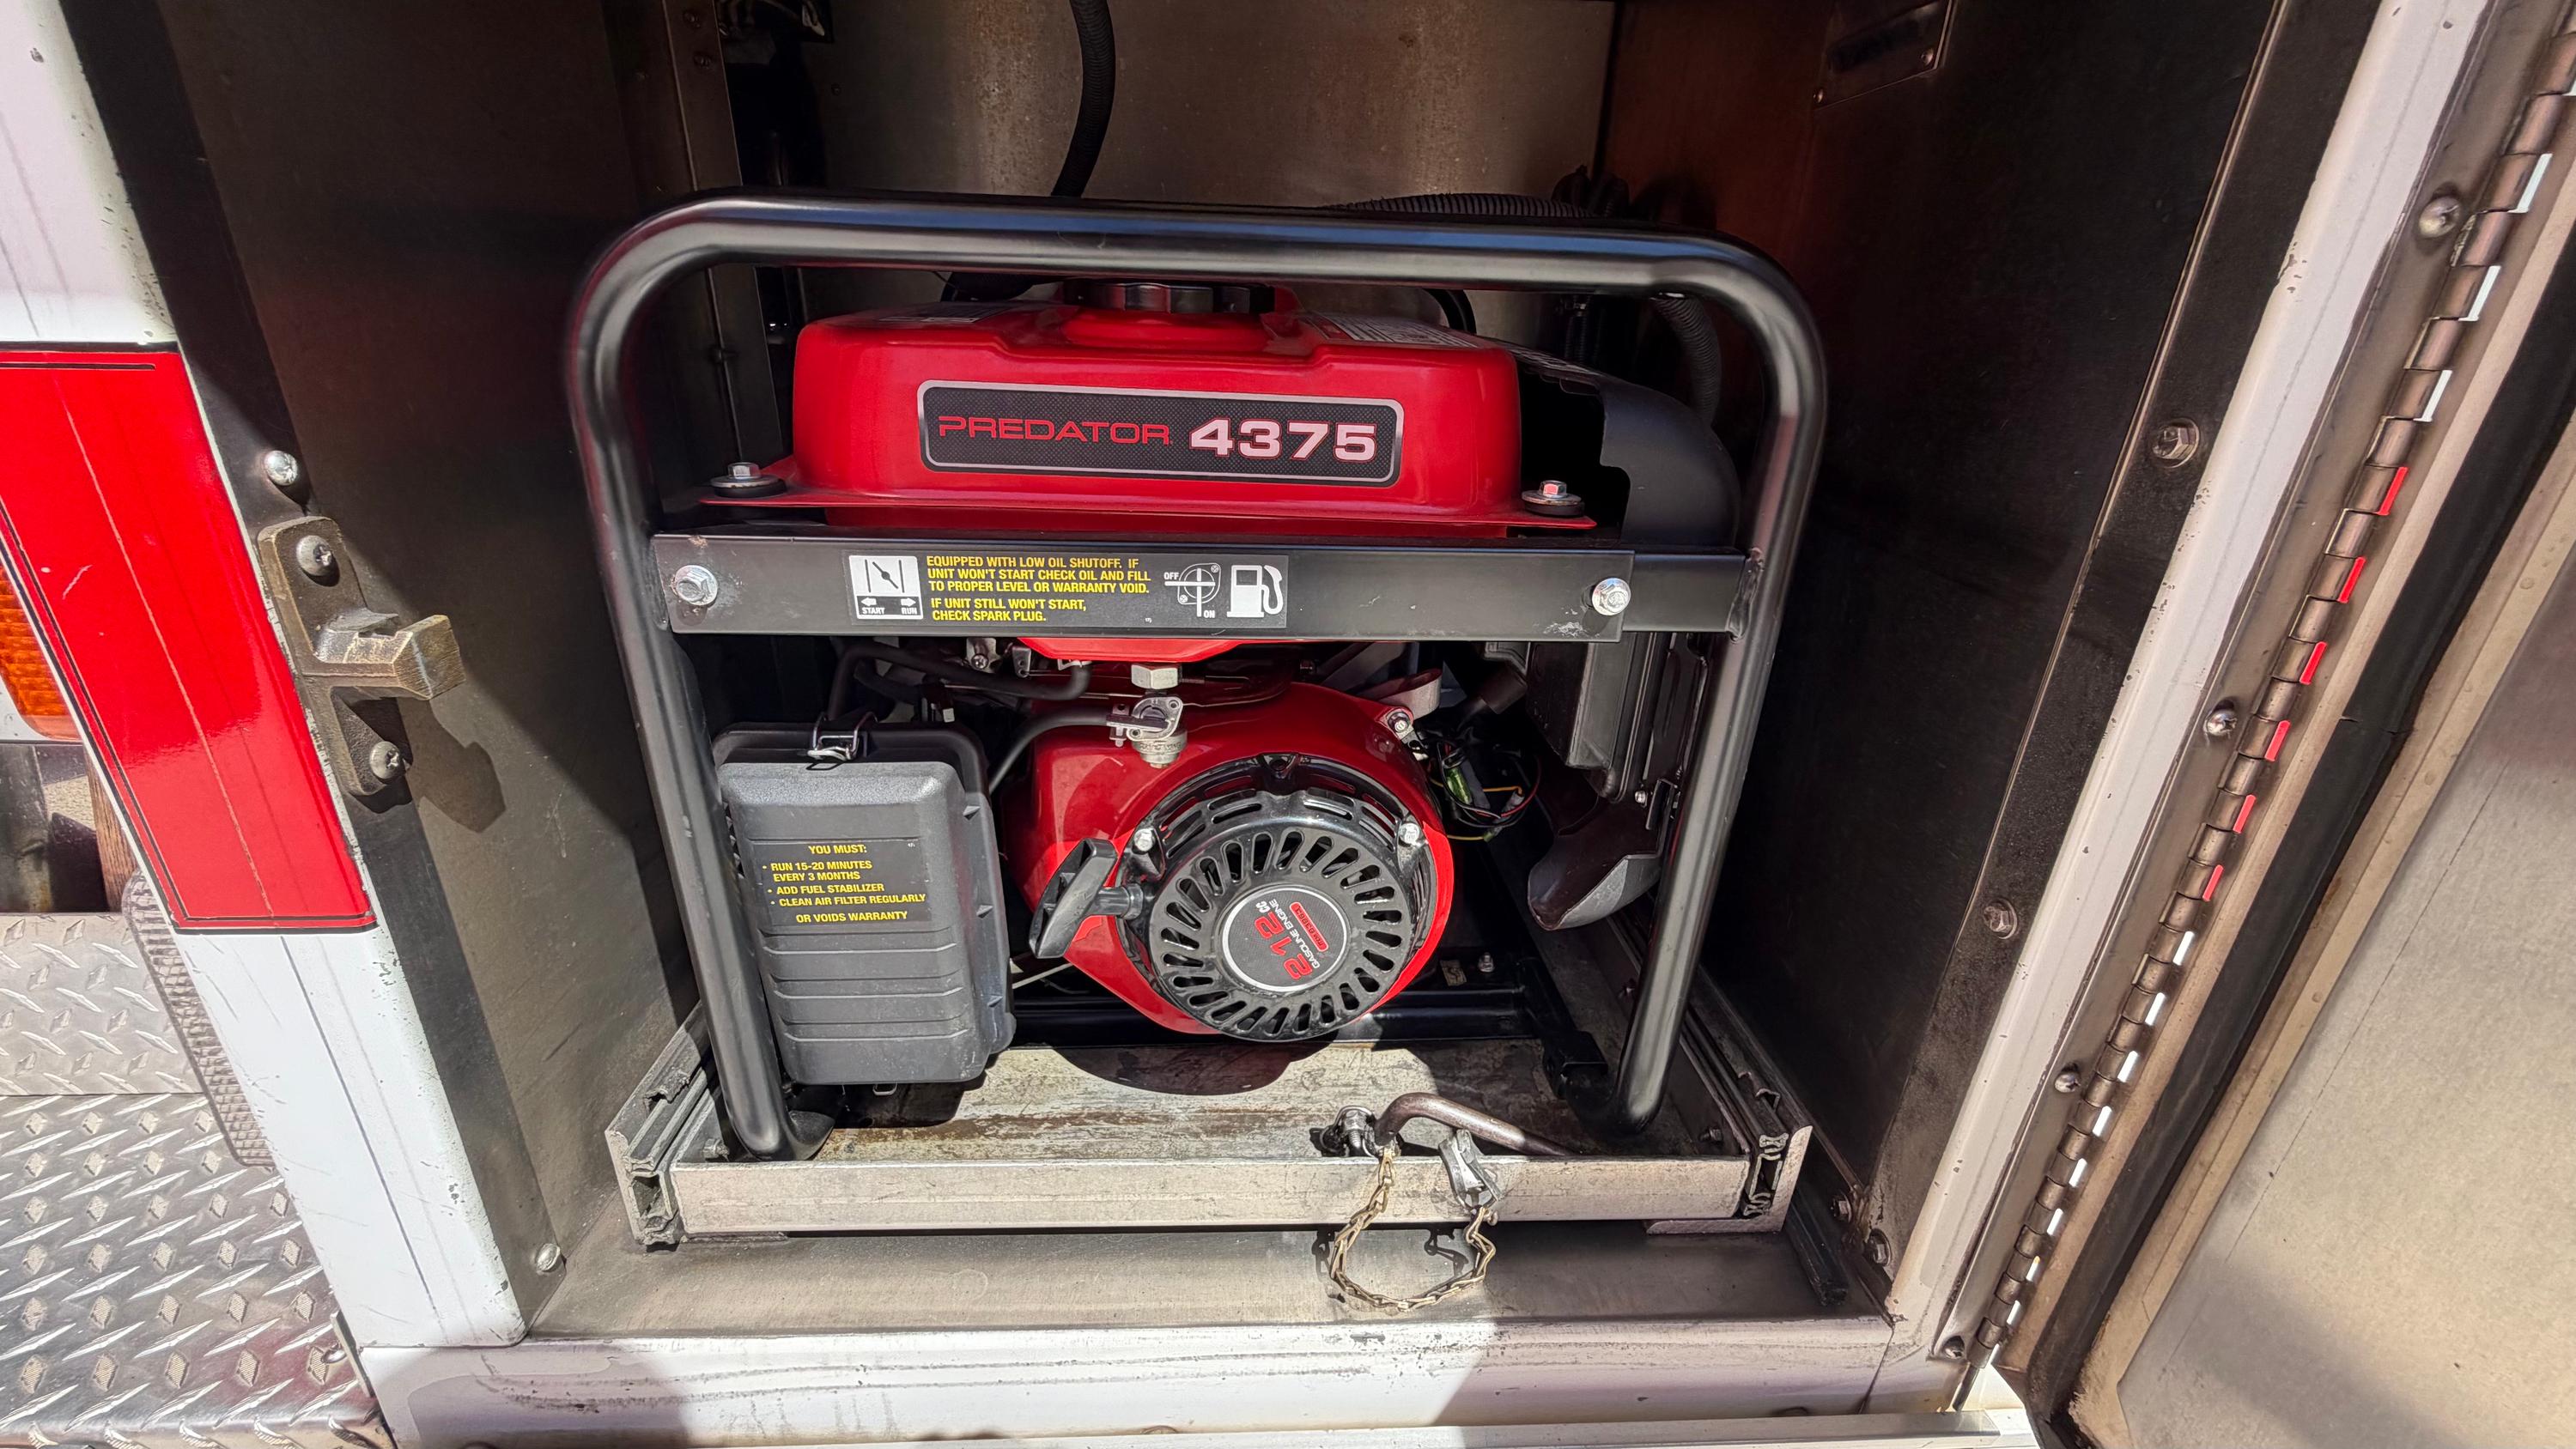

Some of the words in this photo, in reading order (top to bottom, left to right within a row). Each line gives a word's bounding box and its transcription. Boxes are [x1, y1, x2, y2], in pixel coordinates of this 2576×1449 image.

[938, 415, 1171, 446] PREDATOR
[1188, 417, 1378, 464] 4375
[927, 555, 983, 567] EQUIPPED
[987, 556, 1017, 567] WITH
[1019, 557, 1045, 567] LOW
[1048, 557, 1066, 568] OIL
[1069, 558, 1122, 569] SHUTOFF.
[1128, 558, 1139, 569] IF
[927, 568, 955, 579] UNIT
[957, 568, 996, 579] WON'T
[999, 569, 1036, 580] START
[1038, 569, 1076, 580] CHECK
[1078, 570, 1098, 581] OIL
[1100, 570, 1125, 581] AND
[1127, 571, 1151, 581] FILL
[1163, 572, 1180, 580] OFF
[928, 580, 945, 591] TO
[947, 581, 993, 592] PROPER
[996, 581, 1031, 592] LEVEL
[1033, 582, 1050, 592] OR
[1053, 582, 1117, 593] WARRANTY
[1119, 583, 1150, 594] VOID.
[931, 597, 941, 609] IF
[945, 597, 971, 609] UNIT
[974, 598, 1006, 609] STILL
[1008, 598, 1046, 609] WON'T
[1048, 599, 1086, 611] START,
[932, 610, 971, 621] CHECK
[972, 610, 1012, 621] SPARK
[1013, 610, 1047, 621] PLUG.
[1203, 609, 1216, 618] ON
[808, 846, 831, 855] YOU
[834, 844, 867, 853] MUST:
[770, 862, 793, 871] RUN
[795, 862, 824, 870] 15-20
[827, 860, 872, 870] MINUTES
[773, 873, 805, 882] EVERY
[817, 871, 860, 881] MONTHS
[776, 886, 798, 894] ADD
[800, 886, 825, 894] FUEL
[828, 883, 884, 893] STABILIZER
[779, 898, 812, 906] CLEAN
[815, 897, 831, 906] AIR
[834, 896, 867, 906] FILTER
[870, 894, 926, 904] REGULARLY
[795, 913, 811, 923] OR
[815, 912, 847, 922] VOIDS
[848, 911, 908, 921] WARRANTY
[1268, 898, 1294, 931] ENGINE
[1255, 911, 1313, 980] 212
[1289, 929, 1321, 969] GASOLINE
